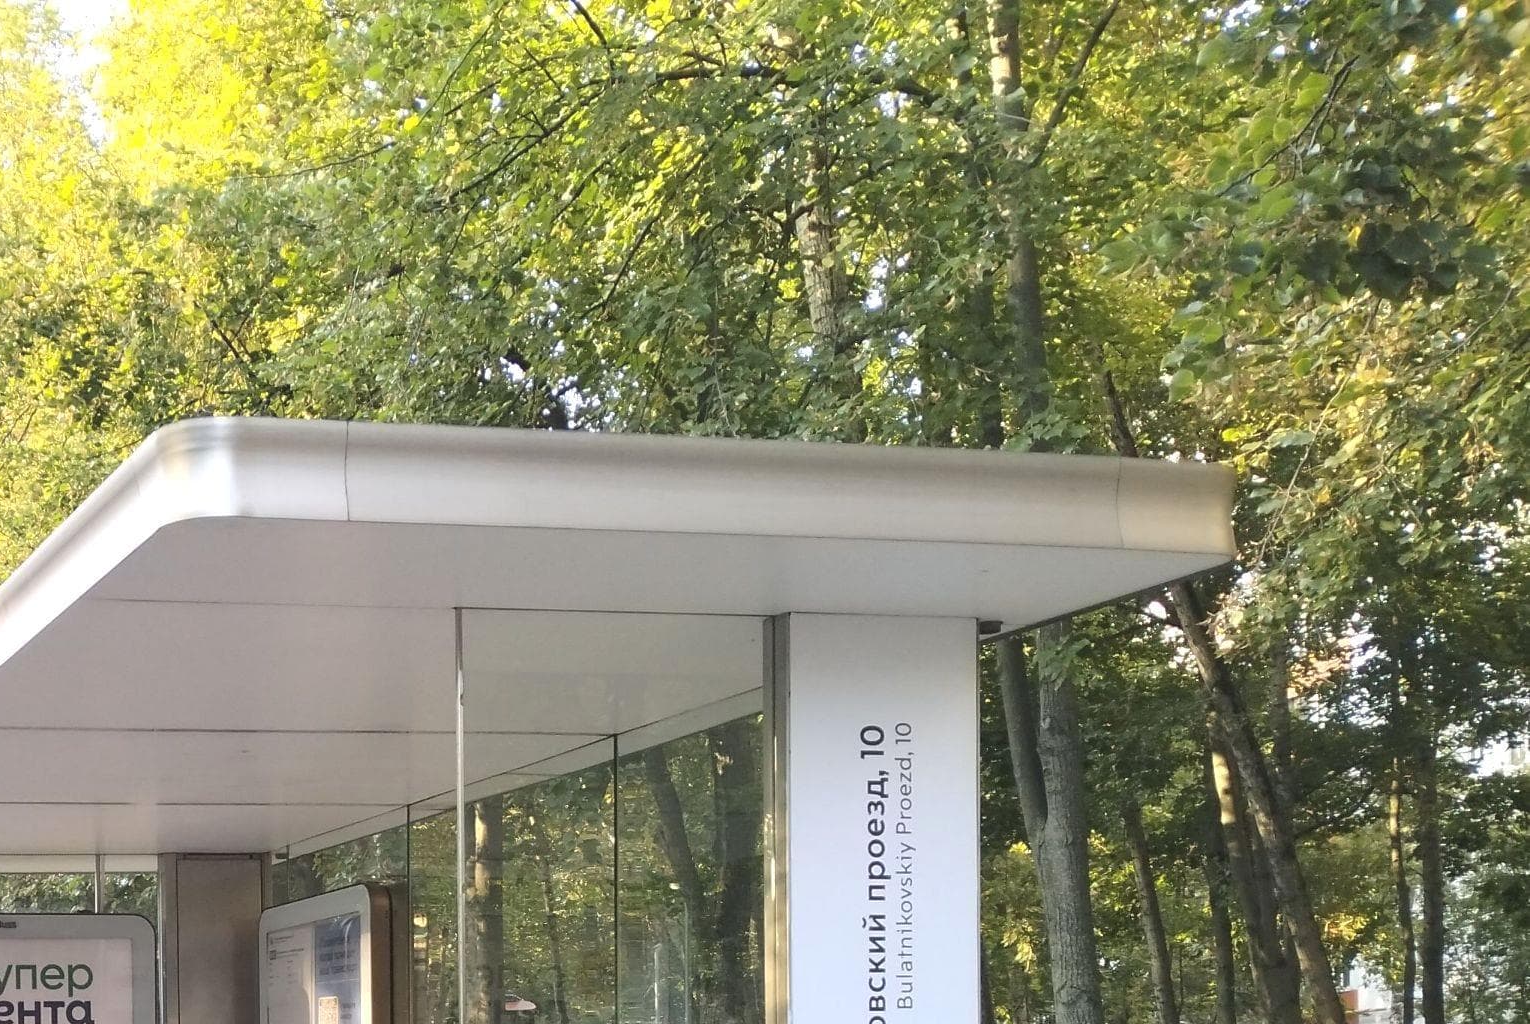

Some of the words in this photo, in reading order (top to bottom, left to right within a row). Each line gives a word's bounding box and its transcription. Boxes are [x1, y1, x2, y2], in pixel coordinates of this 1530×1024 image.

[860, 725, 885, 758] 10
[895, 723, 912, 744] 10
[895, 751, 914, 834] Proezd,
[864, 769, 891, 902] проезд,
[896, 842, 916, 1010] Bulatnikovskiy
